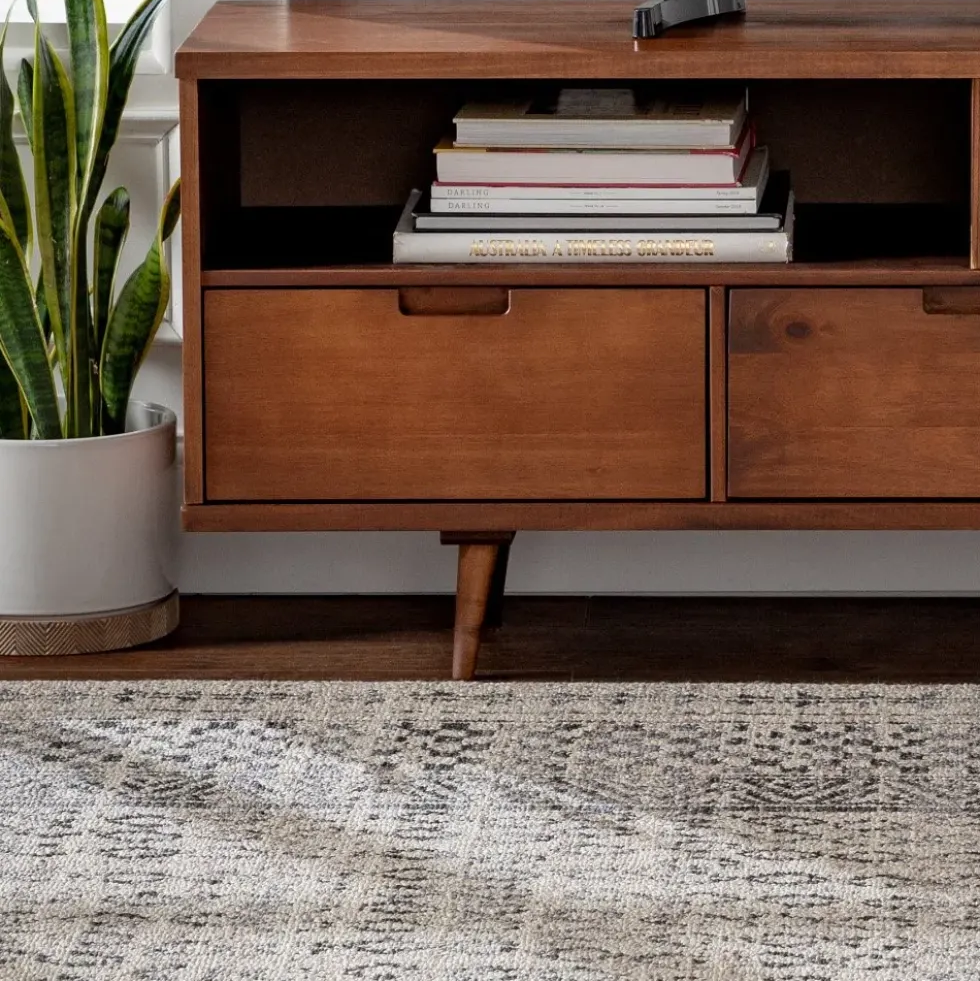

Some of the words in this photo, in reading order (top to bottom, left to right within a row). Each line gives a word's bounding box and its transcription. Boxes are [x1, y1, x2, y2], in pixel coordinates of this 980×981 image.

[447, 189, 490, 197] DARLING
[448, 202, 491, 210] DARLING
[469, 238, 548, 256] AUSTRALIA
[552, 238, 562, 256] A
[566, 238, 633, 256] TIMELESS
[636, 238, 715, 256] GRANDEUR
